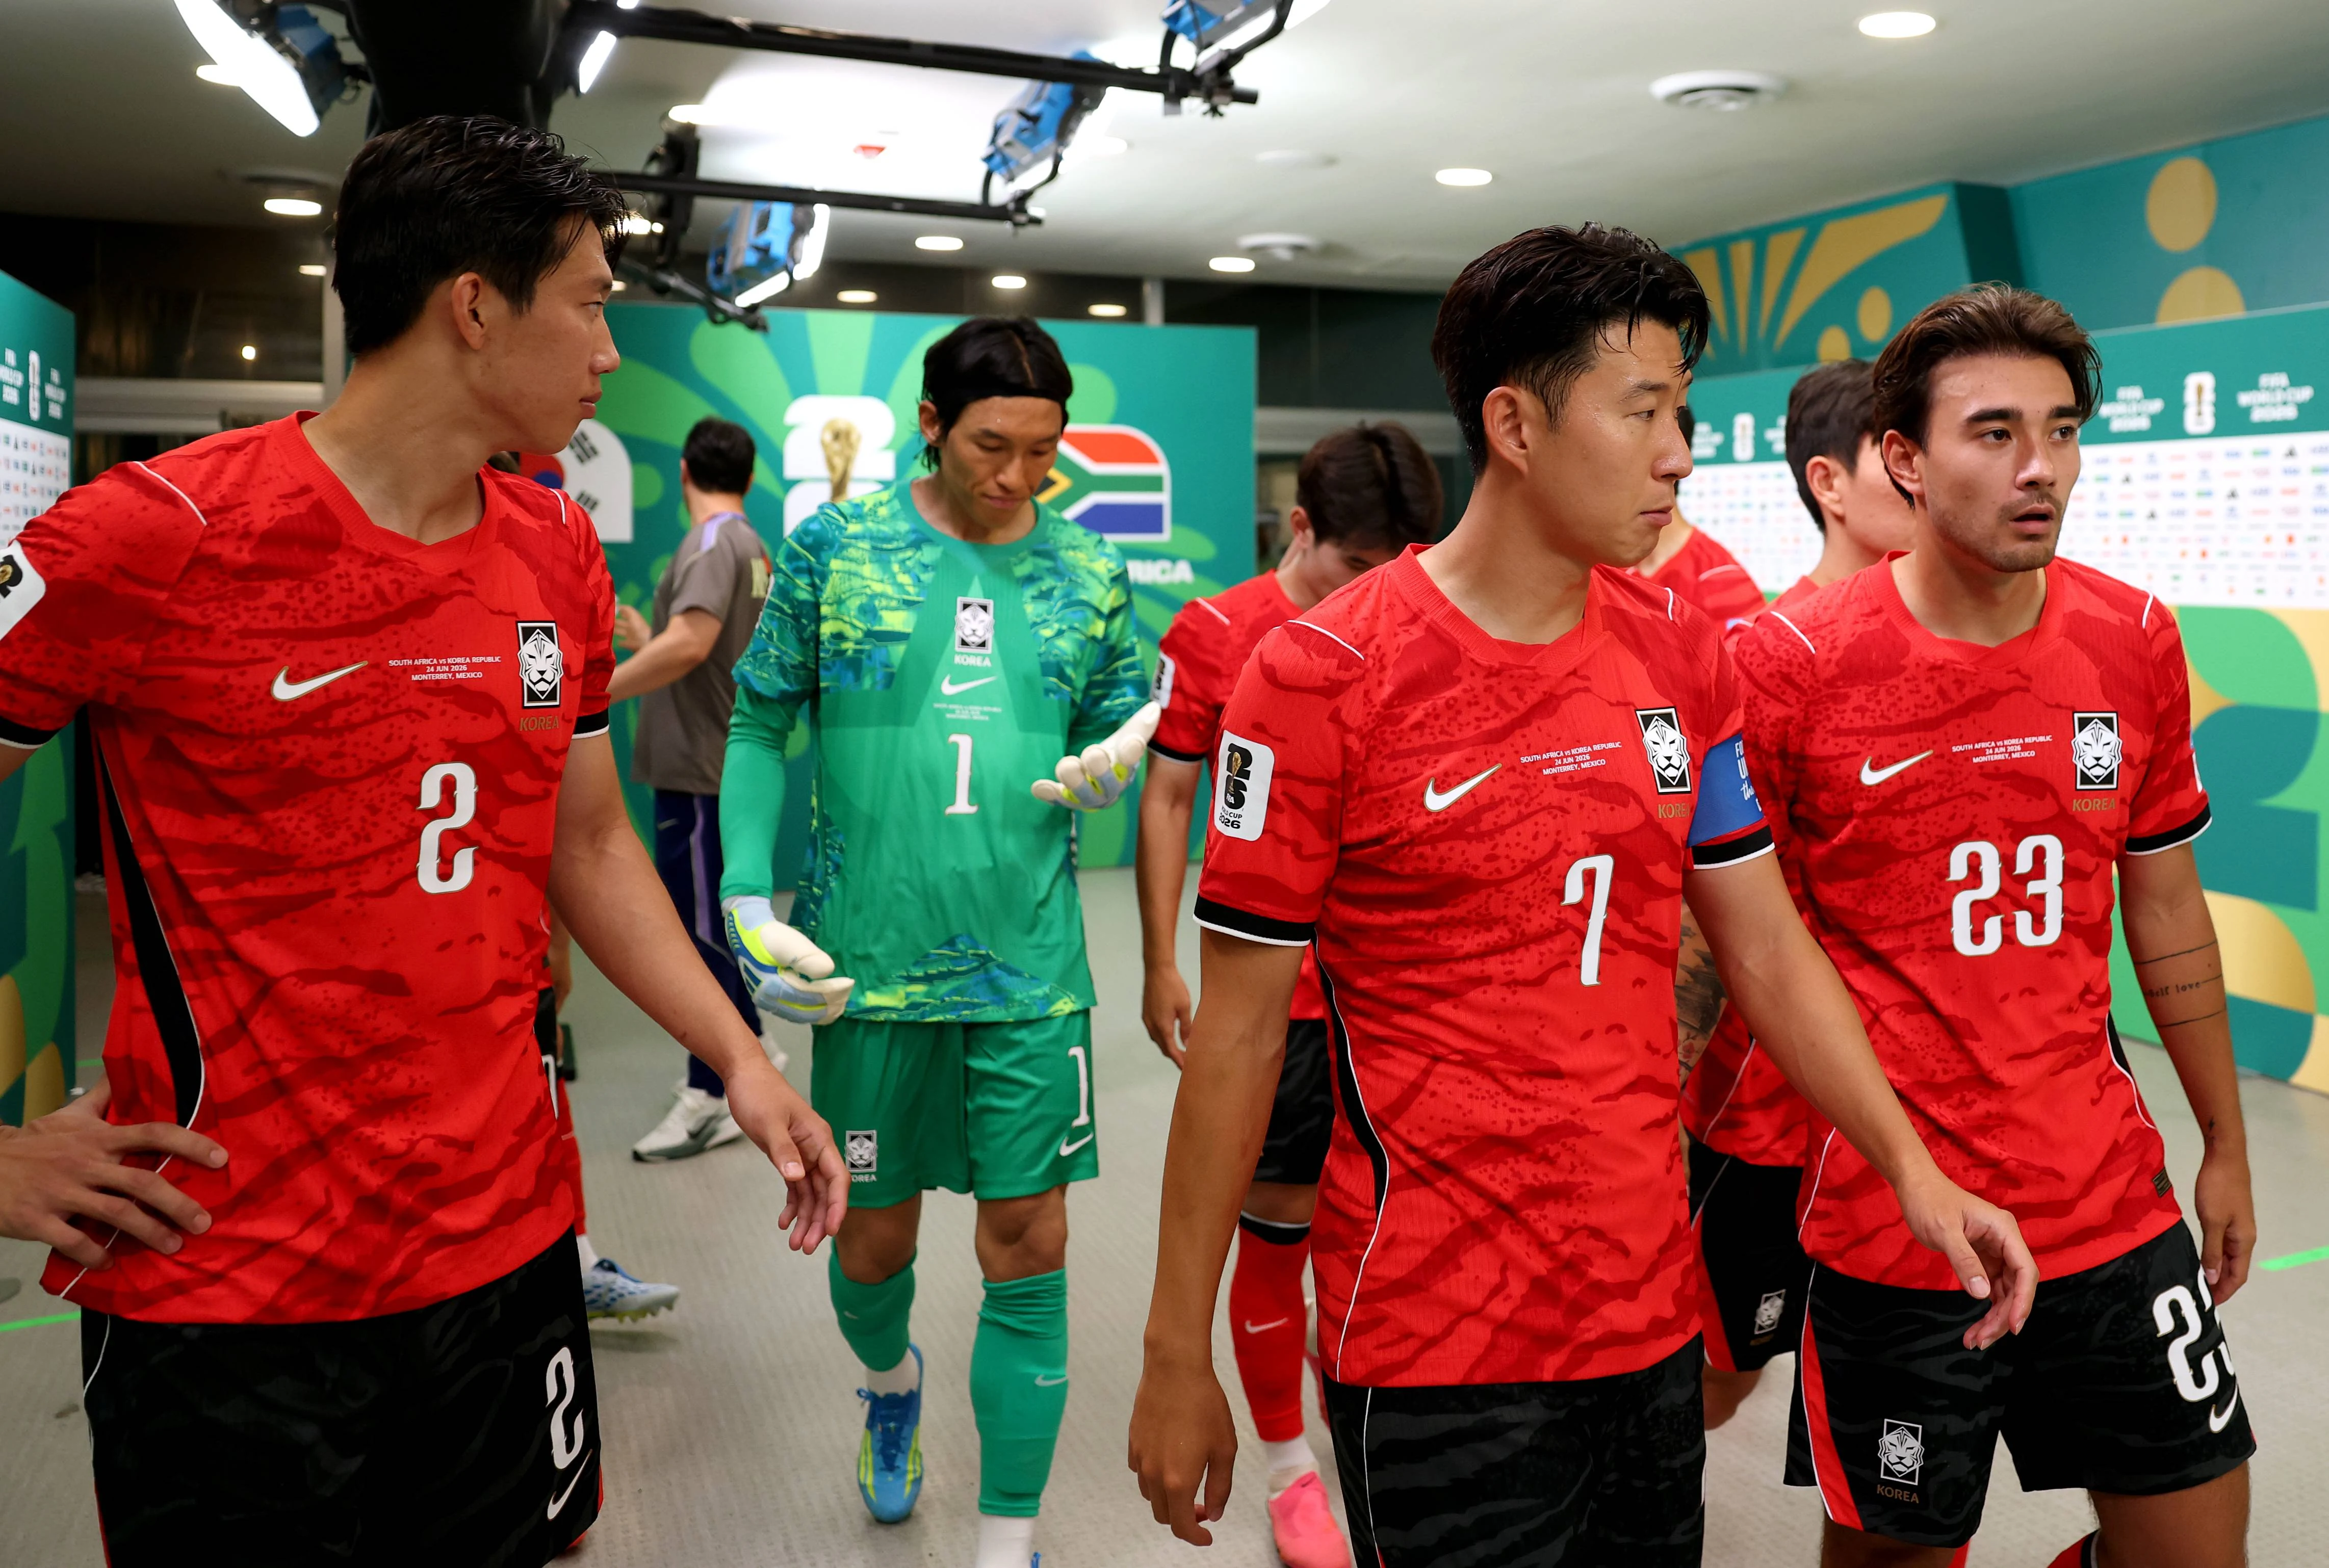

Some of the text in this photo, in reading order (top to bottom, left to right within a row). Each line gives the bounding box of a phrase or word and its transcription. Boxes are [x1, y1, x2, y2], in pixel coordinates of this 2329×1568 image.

[1126, 559, 1195, 585] RICA
[954, 654, 992, 667] KOREA
[519, 716, 559, 731] KOREA
[1520, 754, 1541, 763] SOUTH
[1542, 750, 1564, 760] AFRICA
[1571, 745, 1592, 755] KOREA
[1593, 742, 1622, 751] REPUBLIC
[1952, 743, 1973, 752] SOUTH
[1974, 741, 1996, 749] AFRICA
[2024, 735, 2053, 743] REPUBLIC
[1972, 750, 2036, 763] MONTERREY, MEXICO
[944, 733, 979, 816] 1
[1542, 759, 1606, 775] MONTERREY, MEXICO
[2072, 797, 2115, 812] KOREA
[416, 761, 480, 895] 2
[1219, 812, 1241, 829] 2026
[1945, 833, 2065, 957] 23
[1560, 853, 1615, 987] 7
[2176, 981, 2201, 994] love
[1068, 1046, 1090, 1129] 1
[851, 1174, 877, 1183] OREA
[545, 1346, 584, 1470] 2
[1877, 1484, 1919, 1504] KOREA
